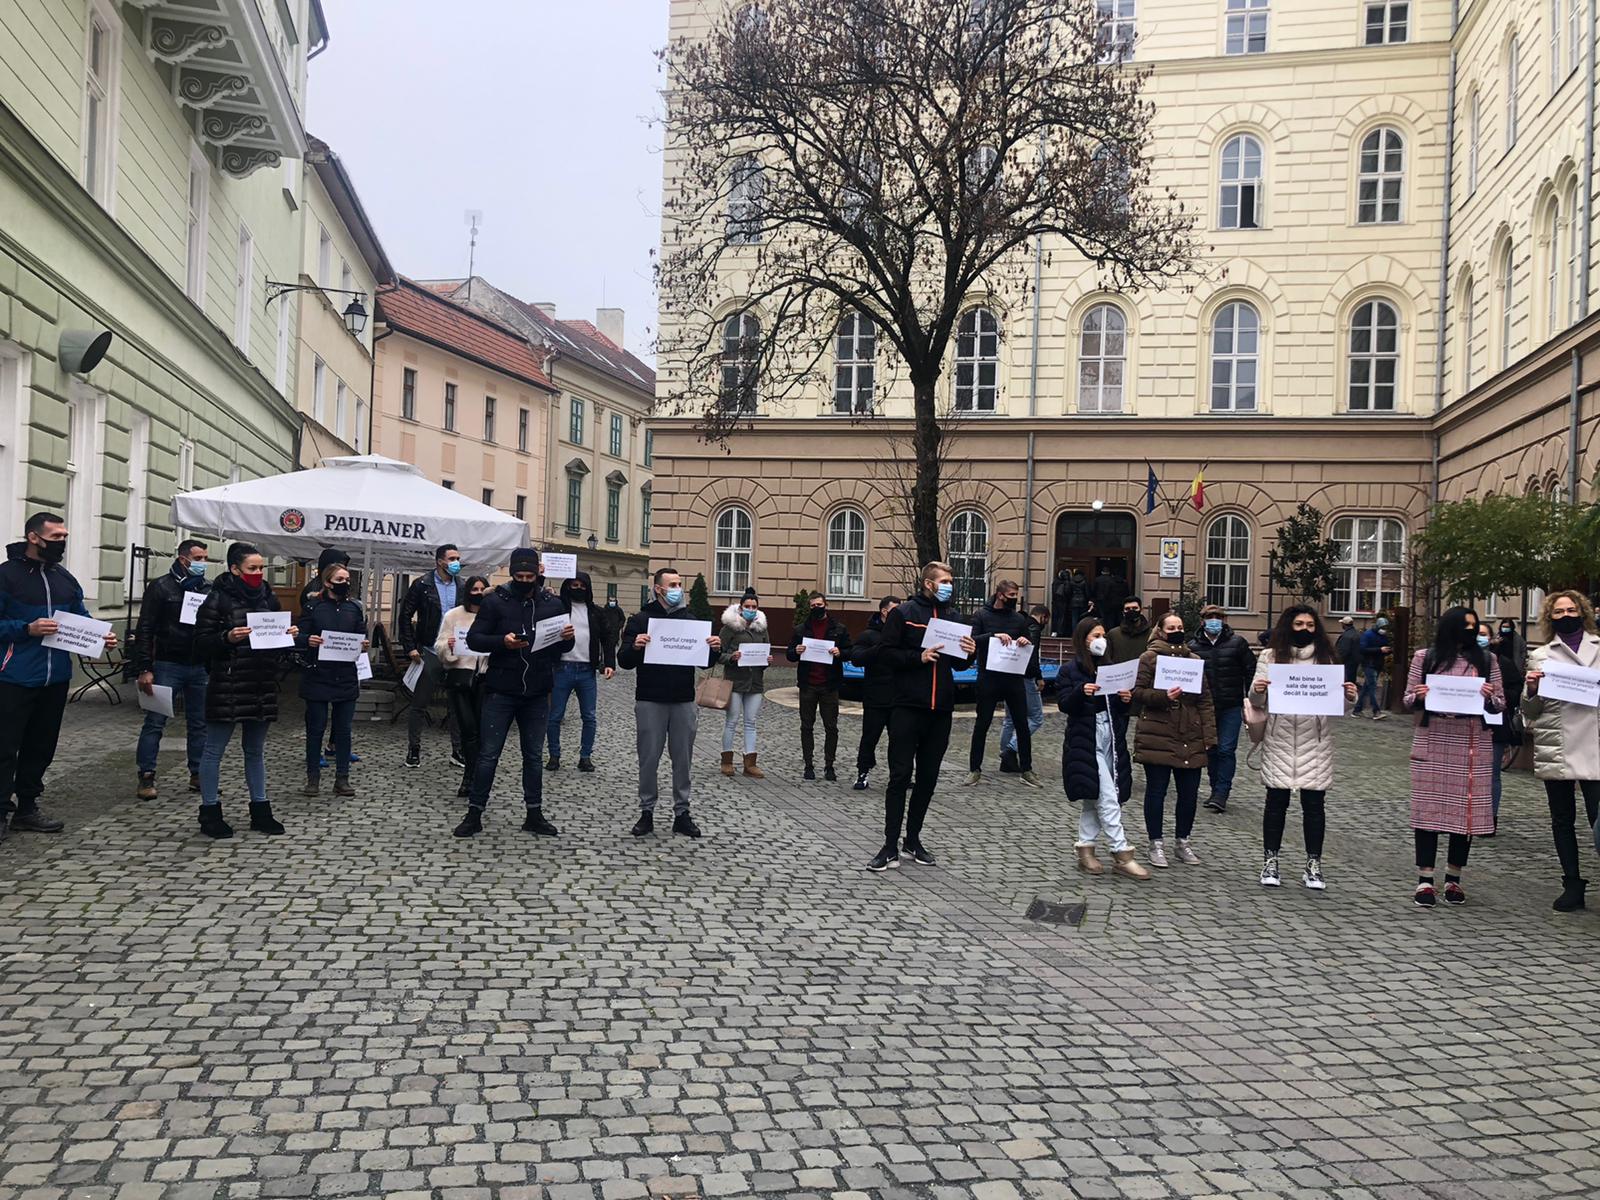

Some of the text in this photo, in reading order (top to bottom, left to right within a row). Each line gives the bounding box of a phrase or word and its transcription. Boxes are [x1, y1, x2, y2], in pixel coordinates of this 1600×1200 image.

[324, 514, 426, 540] PAULANER
[660, 635, 680, 643] Sportul
[1161, 667, 1181, 675] Sportul
